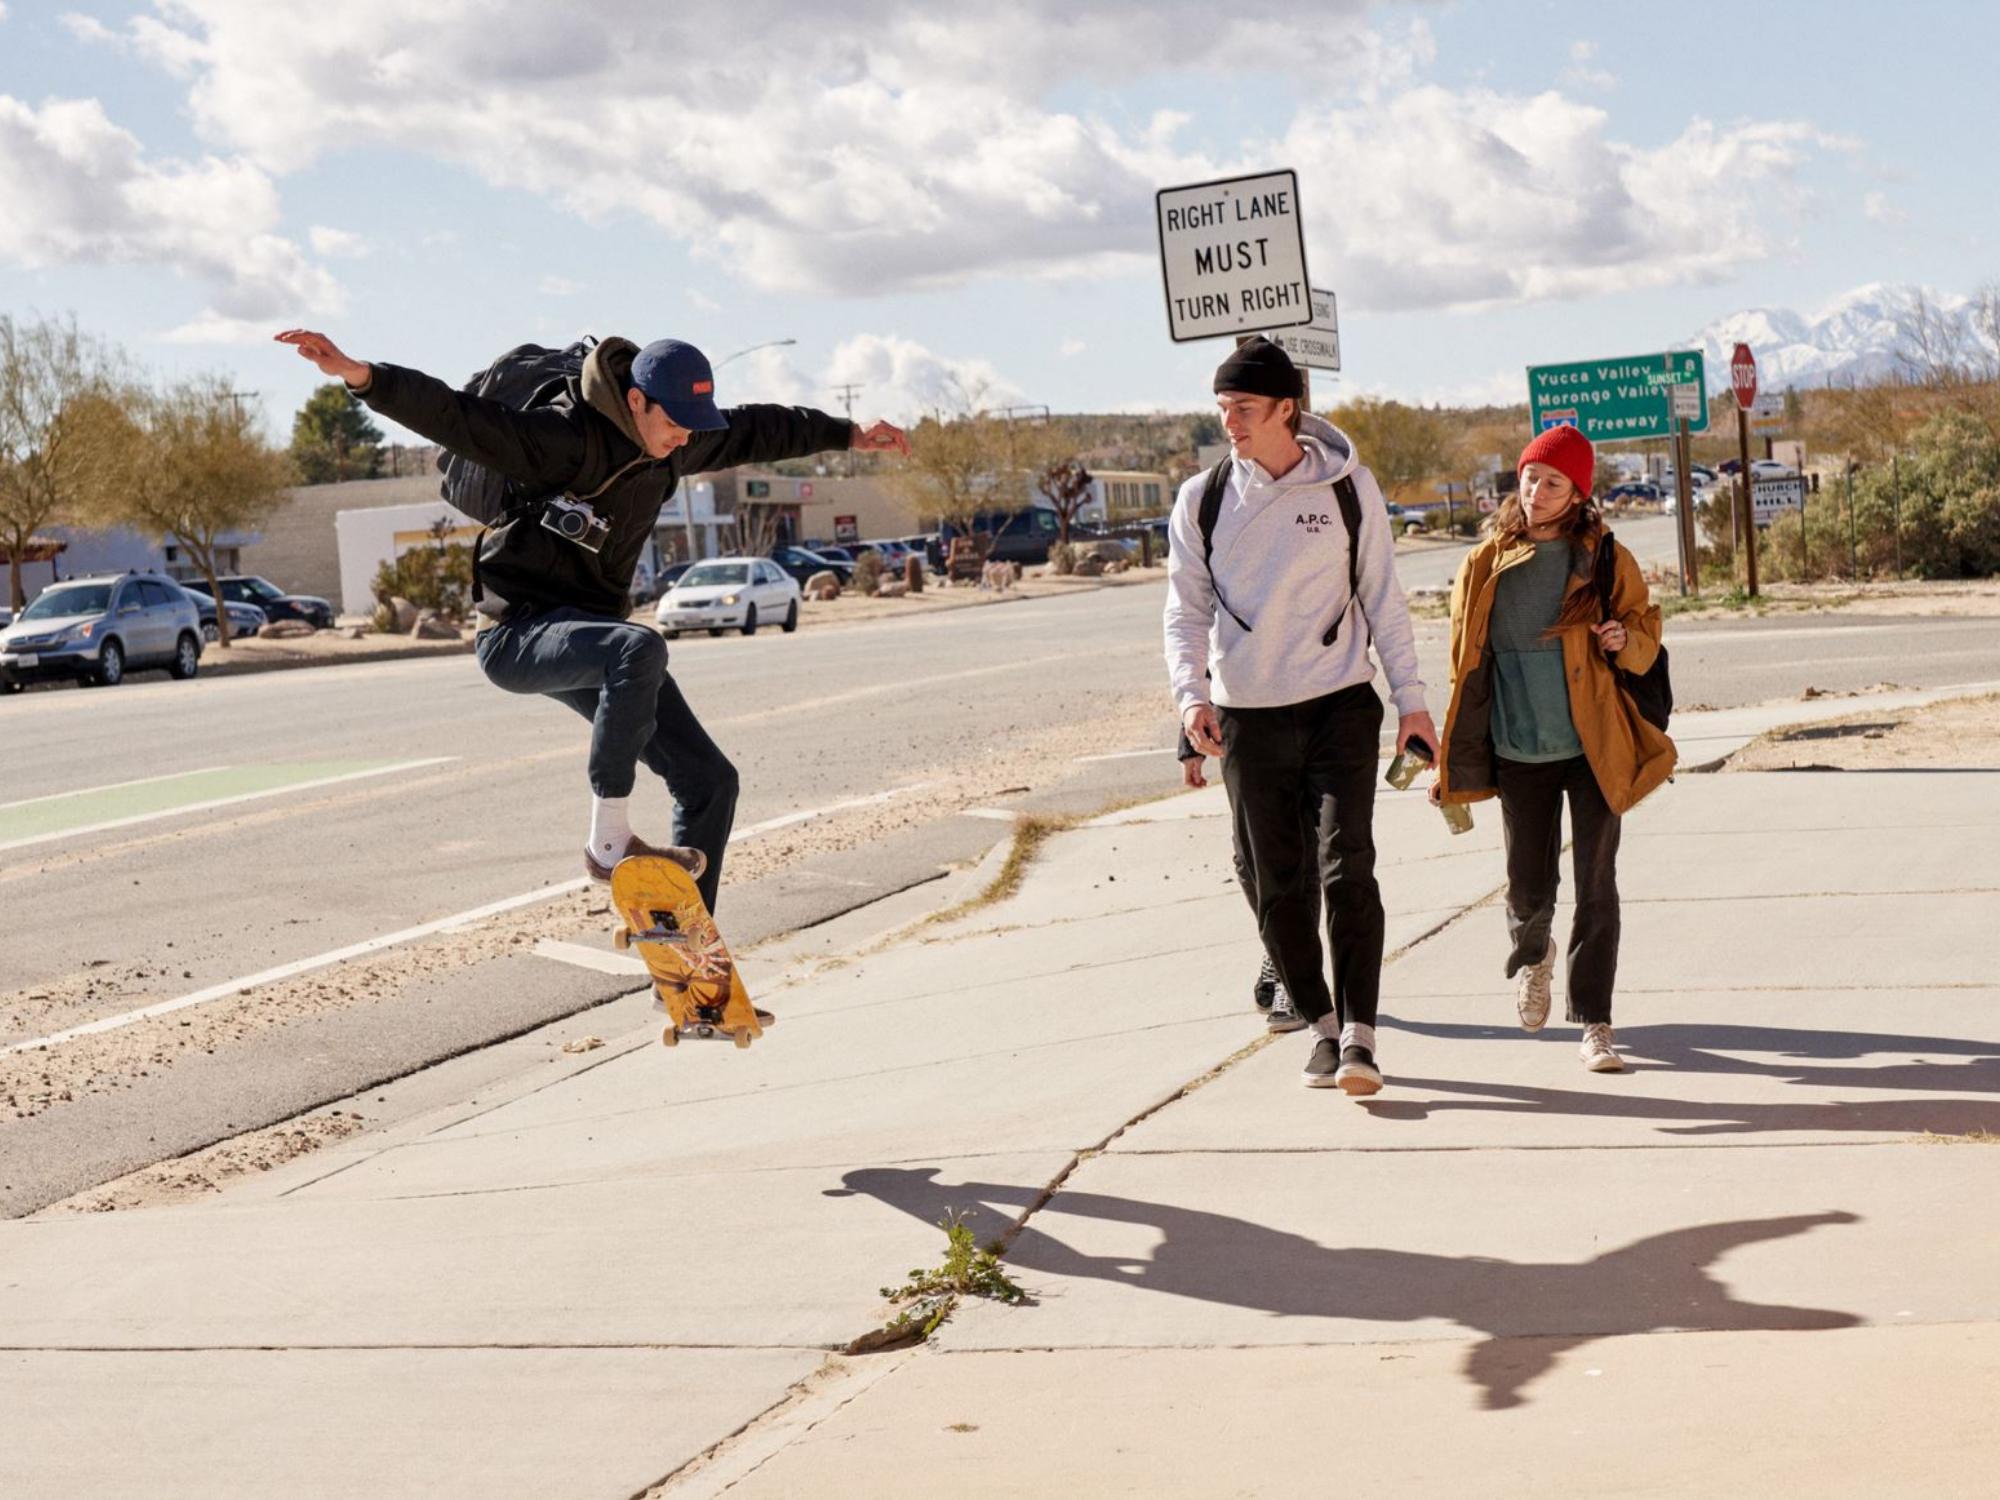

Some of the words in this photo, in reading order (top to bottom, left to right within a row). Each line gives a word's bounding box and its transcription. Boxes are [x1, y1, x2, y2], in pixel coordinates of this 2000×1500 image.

[1167, 201, 1225, 232] RIGHT
[1235, 191, 1290, 221] LANE
[1195, 238, 1269, 276] MUST
[1175, 293, 1230, 321] TURN
[1241, 282, 1300, 313] RIGHT
[1537, 372, 1589, 386] Yucca
[1597, 365, 1651, 380] Valley
[1647, 371, 1681, 386] SUNSET
[1732, 363, 1754, 388] STOP
[1538, 389, 1610, 406] Morongo
[1617, 383, 1668, 399] Valley
[1587, 416, 1658, 431] Freeway
[1754, 483, 1801, 493] HURCH
[1296, 514, 1333, 525] A.P.C.
